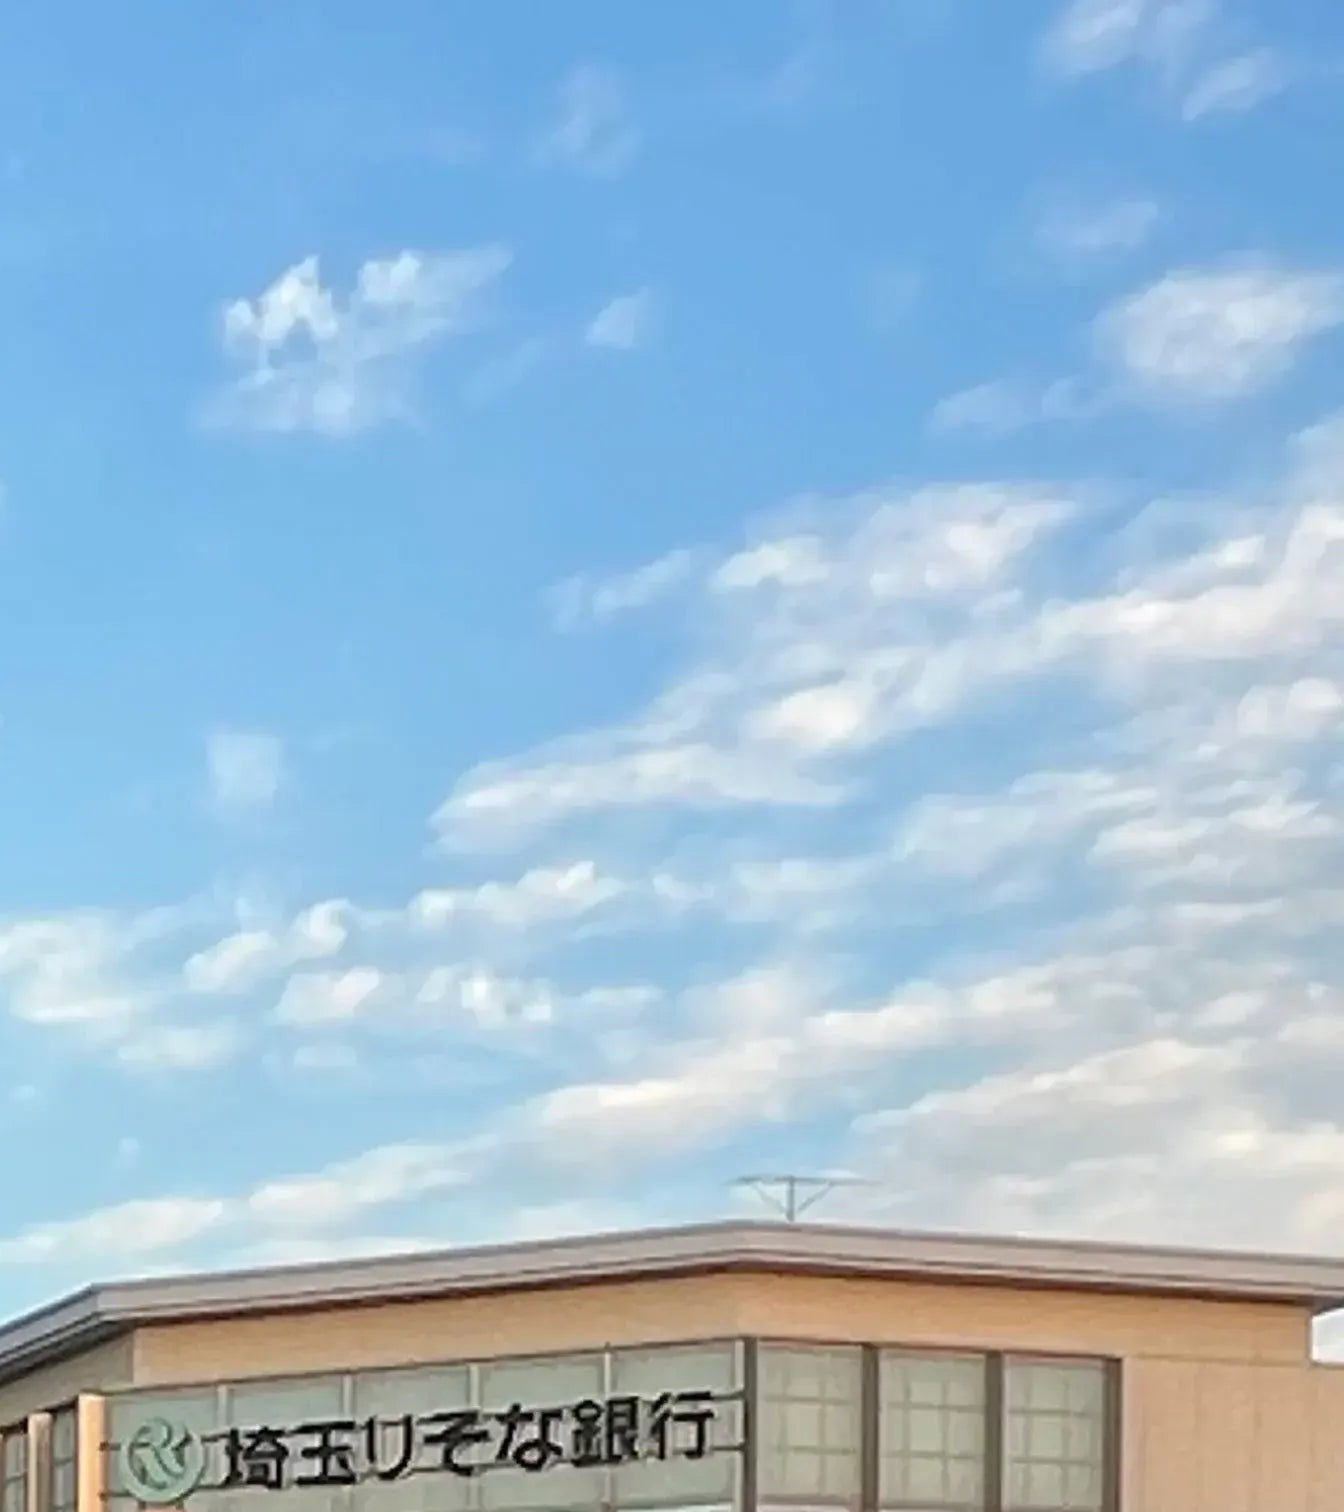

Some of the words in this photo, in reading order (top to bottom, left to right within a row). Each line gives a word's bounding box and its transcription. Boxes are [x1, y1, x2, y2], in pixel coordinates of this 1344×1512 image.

[220, 1391, 716, 1489] 埼玉りそな銀行
